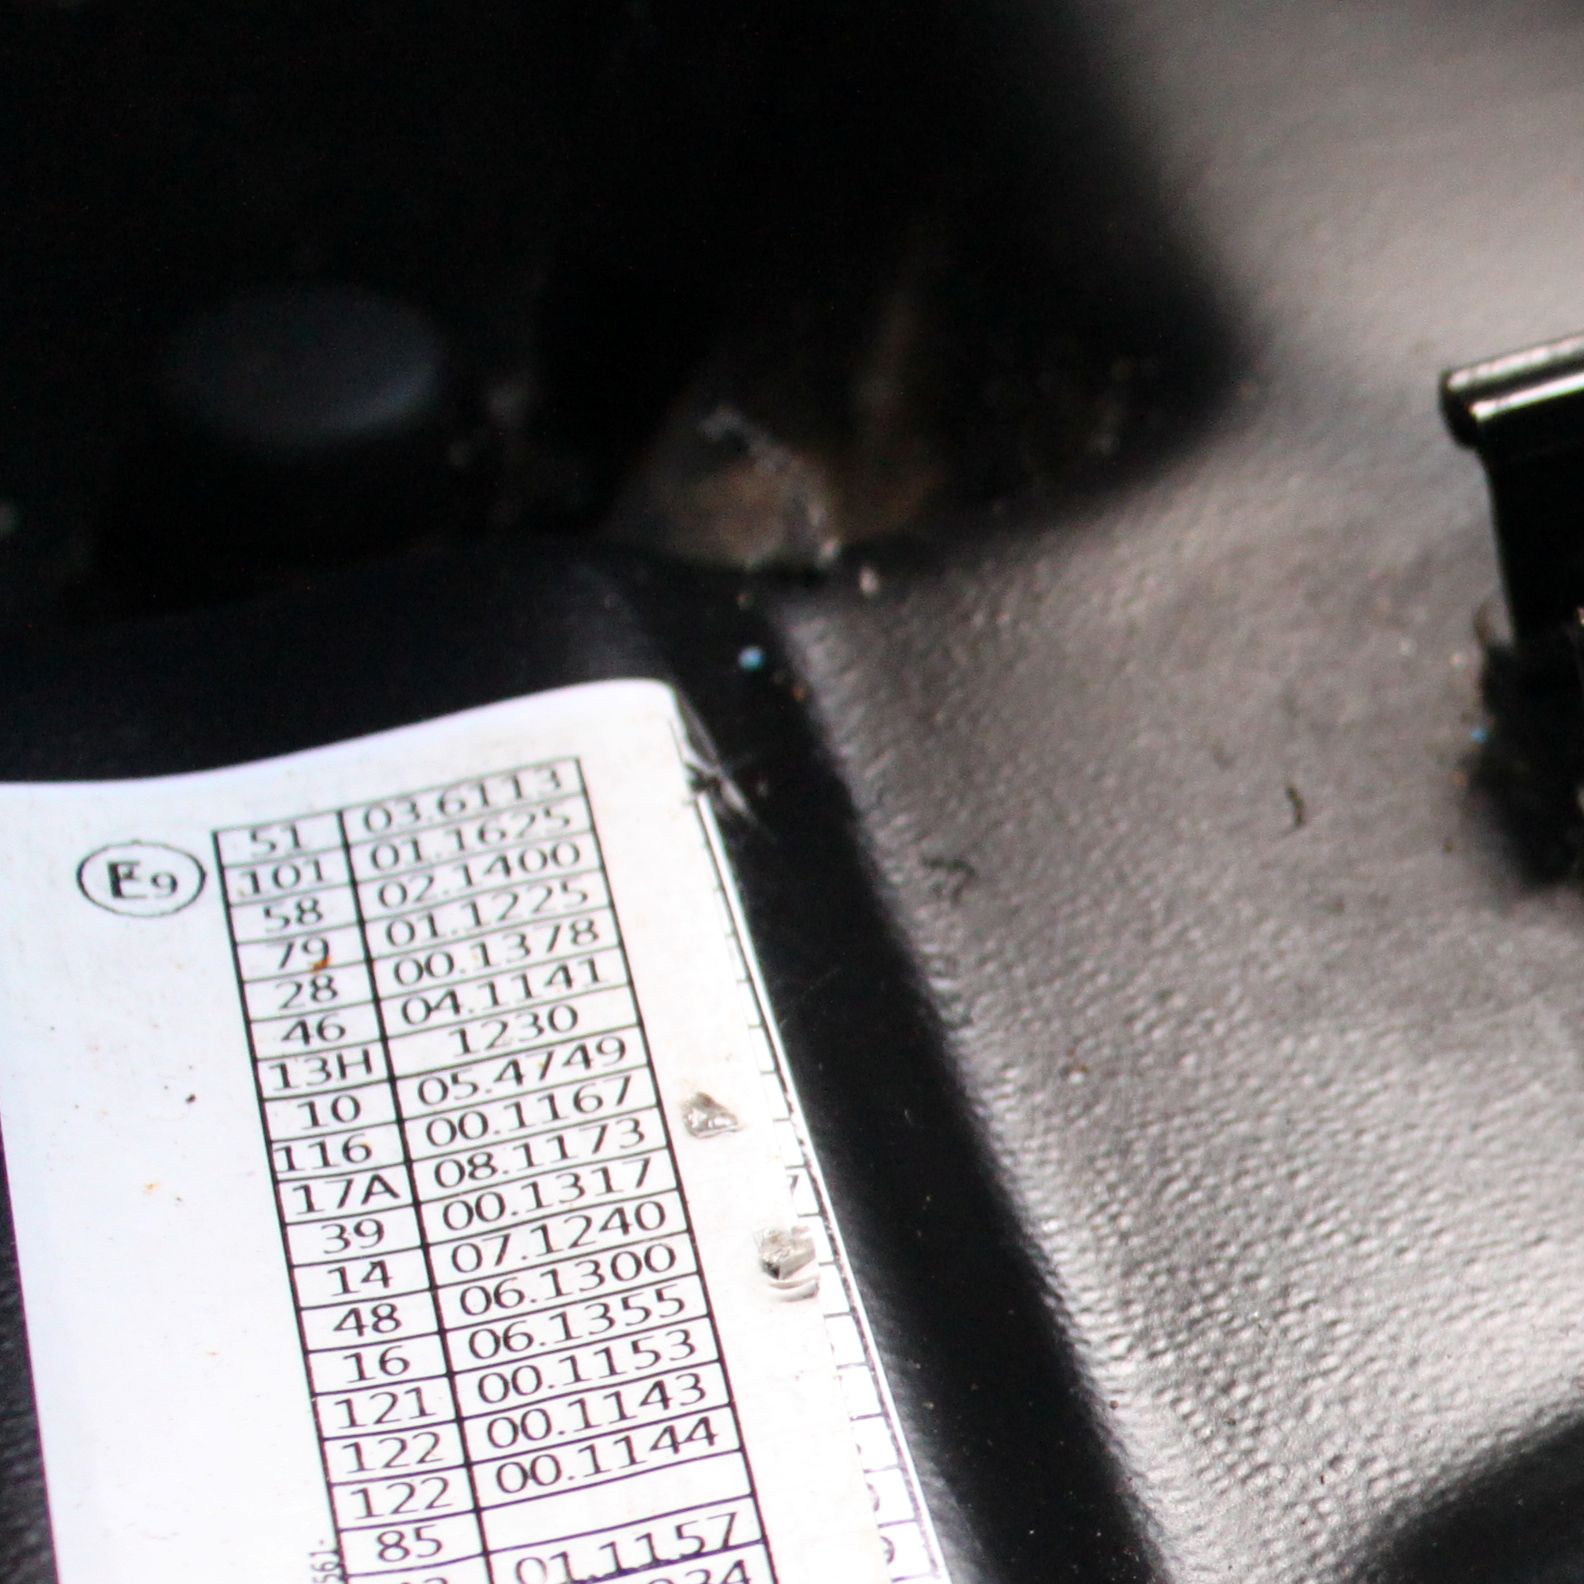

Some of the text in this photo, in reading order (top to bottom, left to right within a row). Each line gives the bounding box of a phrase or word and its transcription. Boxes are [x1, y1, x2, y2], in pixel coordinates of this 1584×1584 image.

[240, 804, 572, 895] 101 01.1625
[249, 766, 564, 859] 51 03.6113
[263, 841, 581, 933] 58 02.1400
[268, 878, 589, 971] 79 01.1225
[275, 917, 601, 1010] 28 00.1378
[281, 957, 610, 1046] 46 04.1141
[268, 1004, 579, 1092] 13H 1230
[297, 1035, 628, 1130] 10 05.4749
[273, 1074, 633, 1175] 116 00.1167
[292, 1116, 647, 1215] 17A 08.1173
[321, 1156, 653, 1256] 39 00.1317
[326, 1200, 668, 1297] 14 07.1240
[333, 1242, 678, 1338] 48 06.1300
[342, 1284, 687, 1384] 16 06.1355
[334, 1327, 697, 1430] 121 00.1153
[342, 1371, 708, 1476] 122 00.1143
[350, 1416, 717, 1520] 122 00.1144
[376, 1524, 445, 1564] 85
